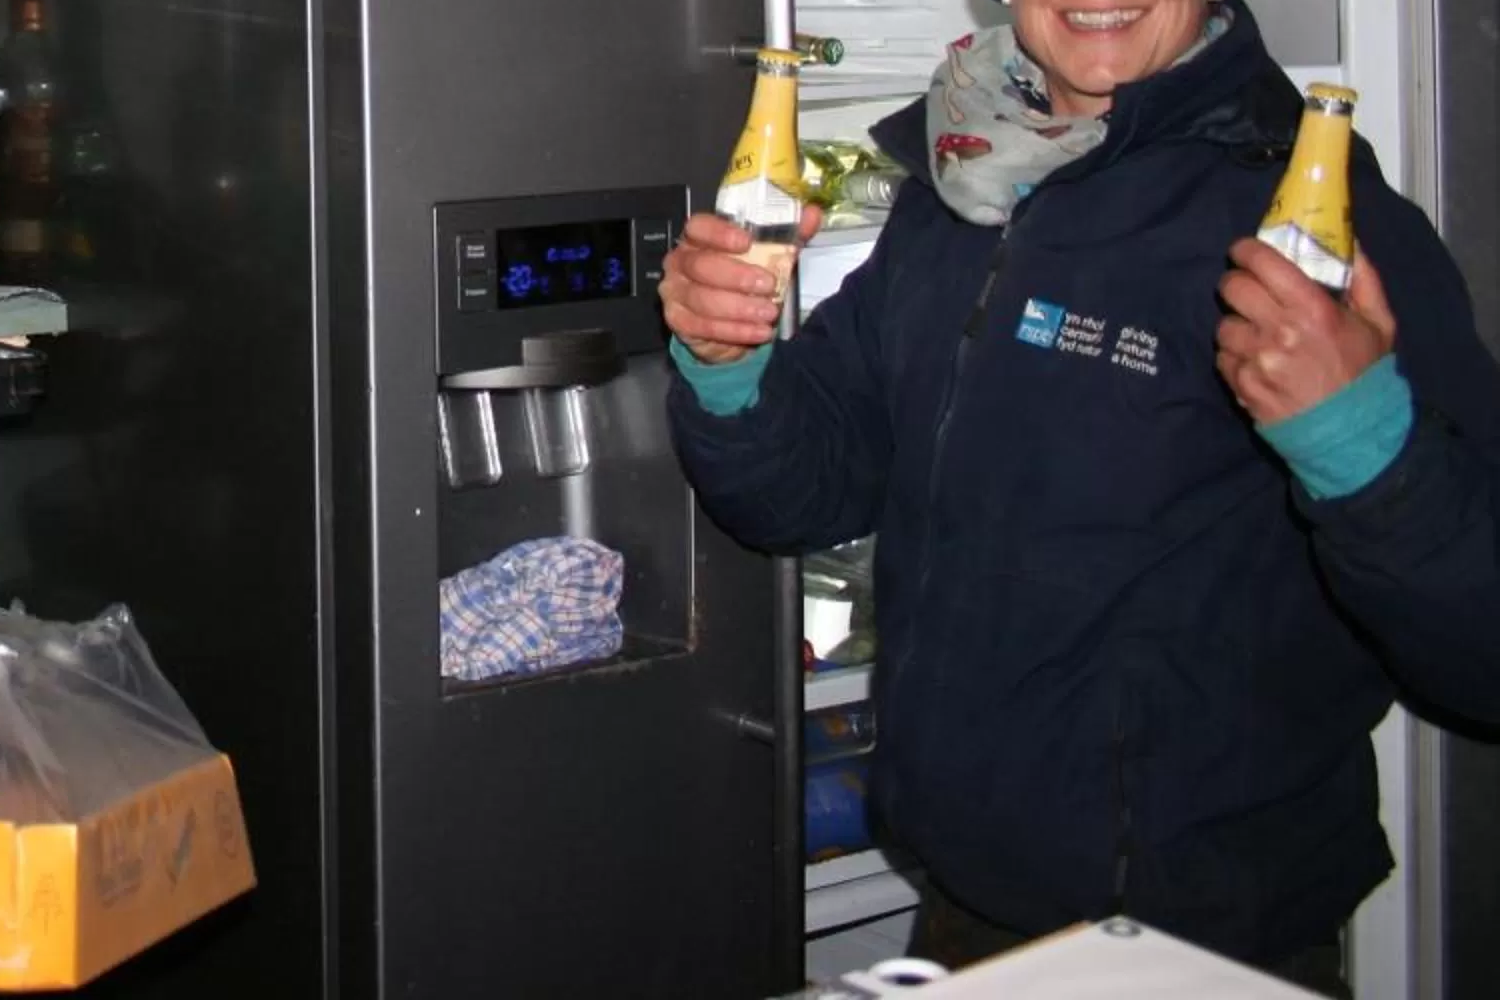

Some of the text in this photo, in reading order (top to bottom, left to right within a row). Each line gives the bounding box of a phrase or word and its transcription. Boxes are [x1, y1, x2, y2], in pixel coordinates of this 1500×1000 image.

[1120, 326, 1159, 348] giving
[1116, 340, 1155, 360] nature
[1121, 353, 1158, 375] home
